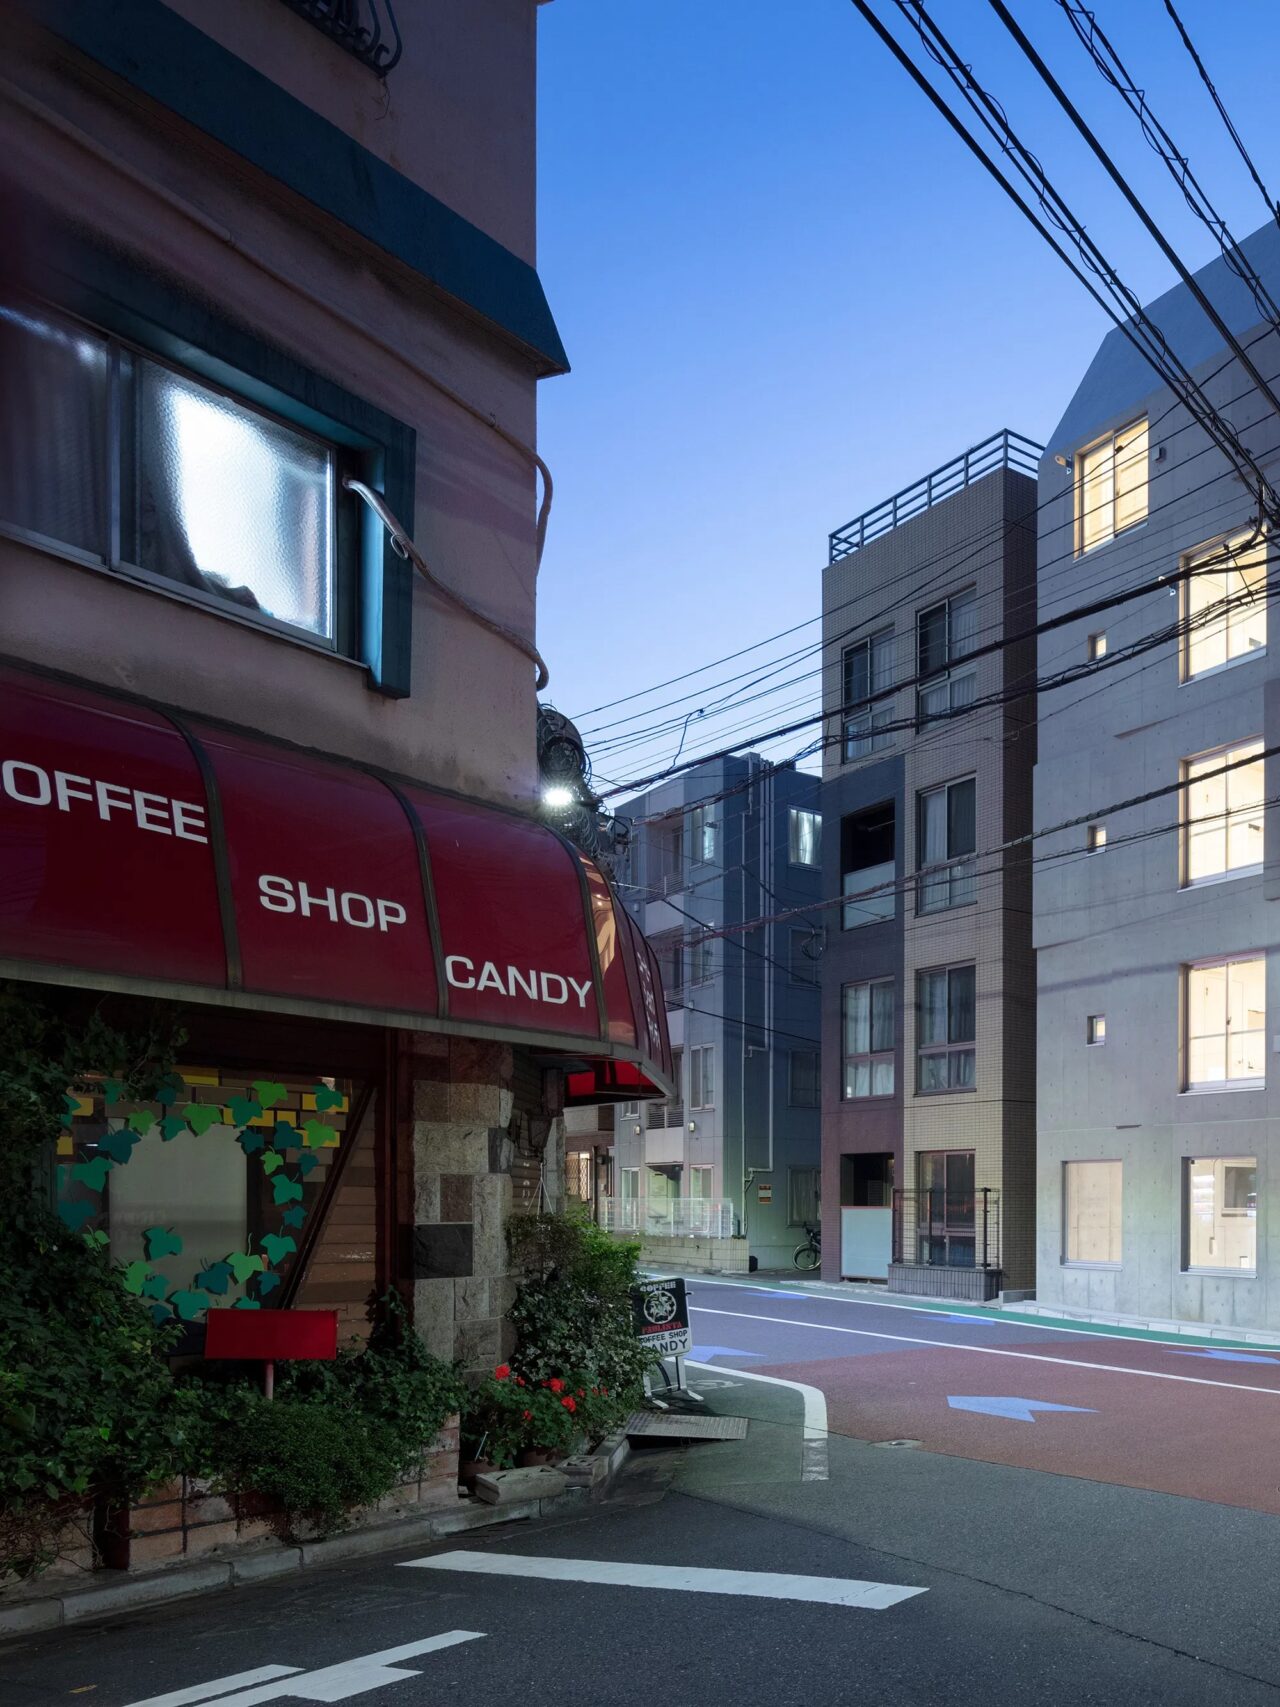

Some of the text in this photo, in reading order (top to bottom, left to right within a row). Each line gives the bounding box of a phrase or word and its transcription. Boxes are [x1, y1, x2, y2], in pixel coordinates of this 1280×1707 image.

[0, 760, 208, 844] OFFEE
[258, 874, 407, 932] SHOP
[445, 955, 593, 1008] CANDY
[668, 1329, 688, 1339] SHOP
